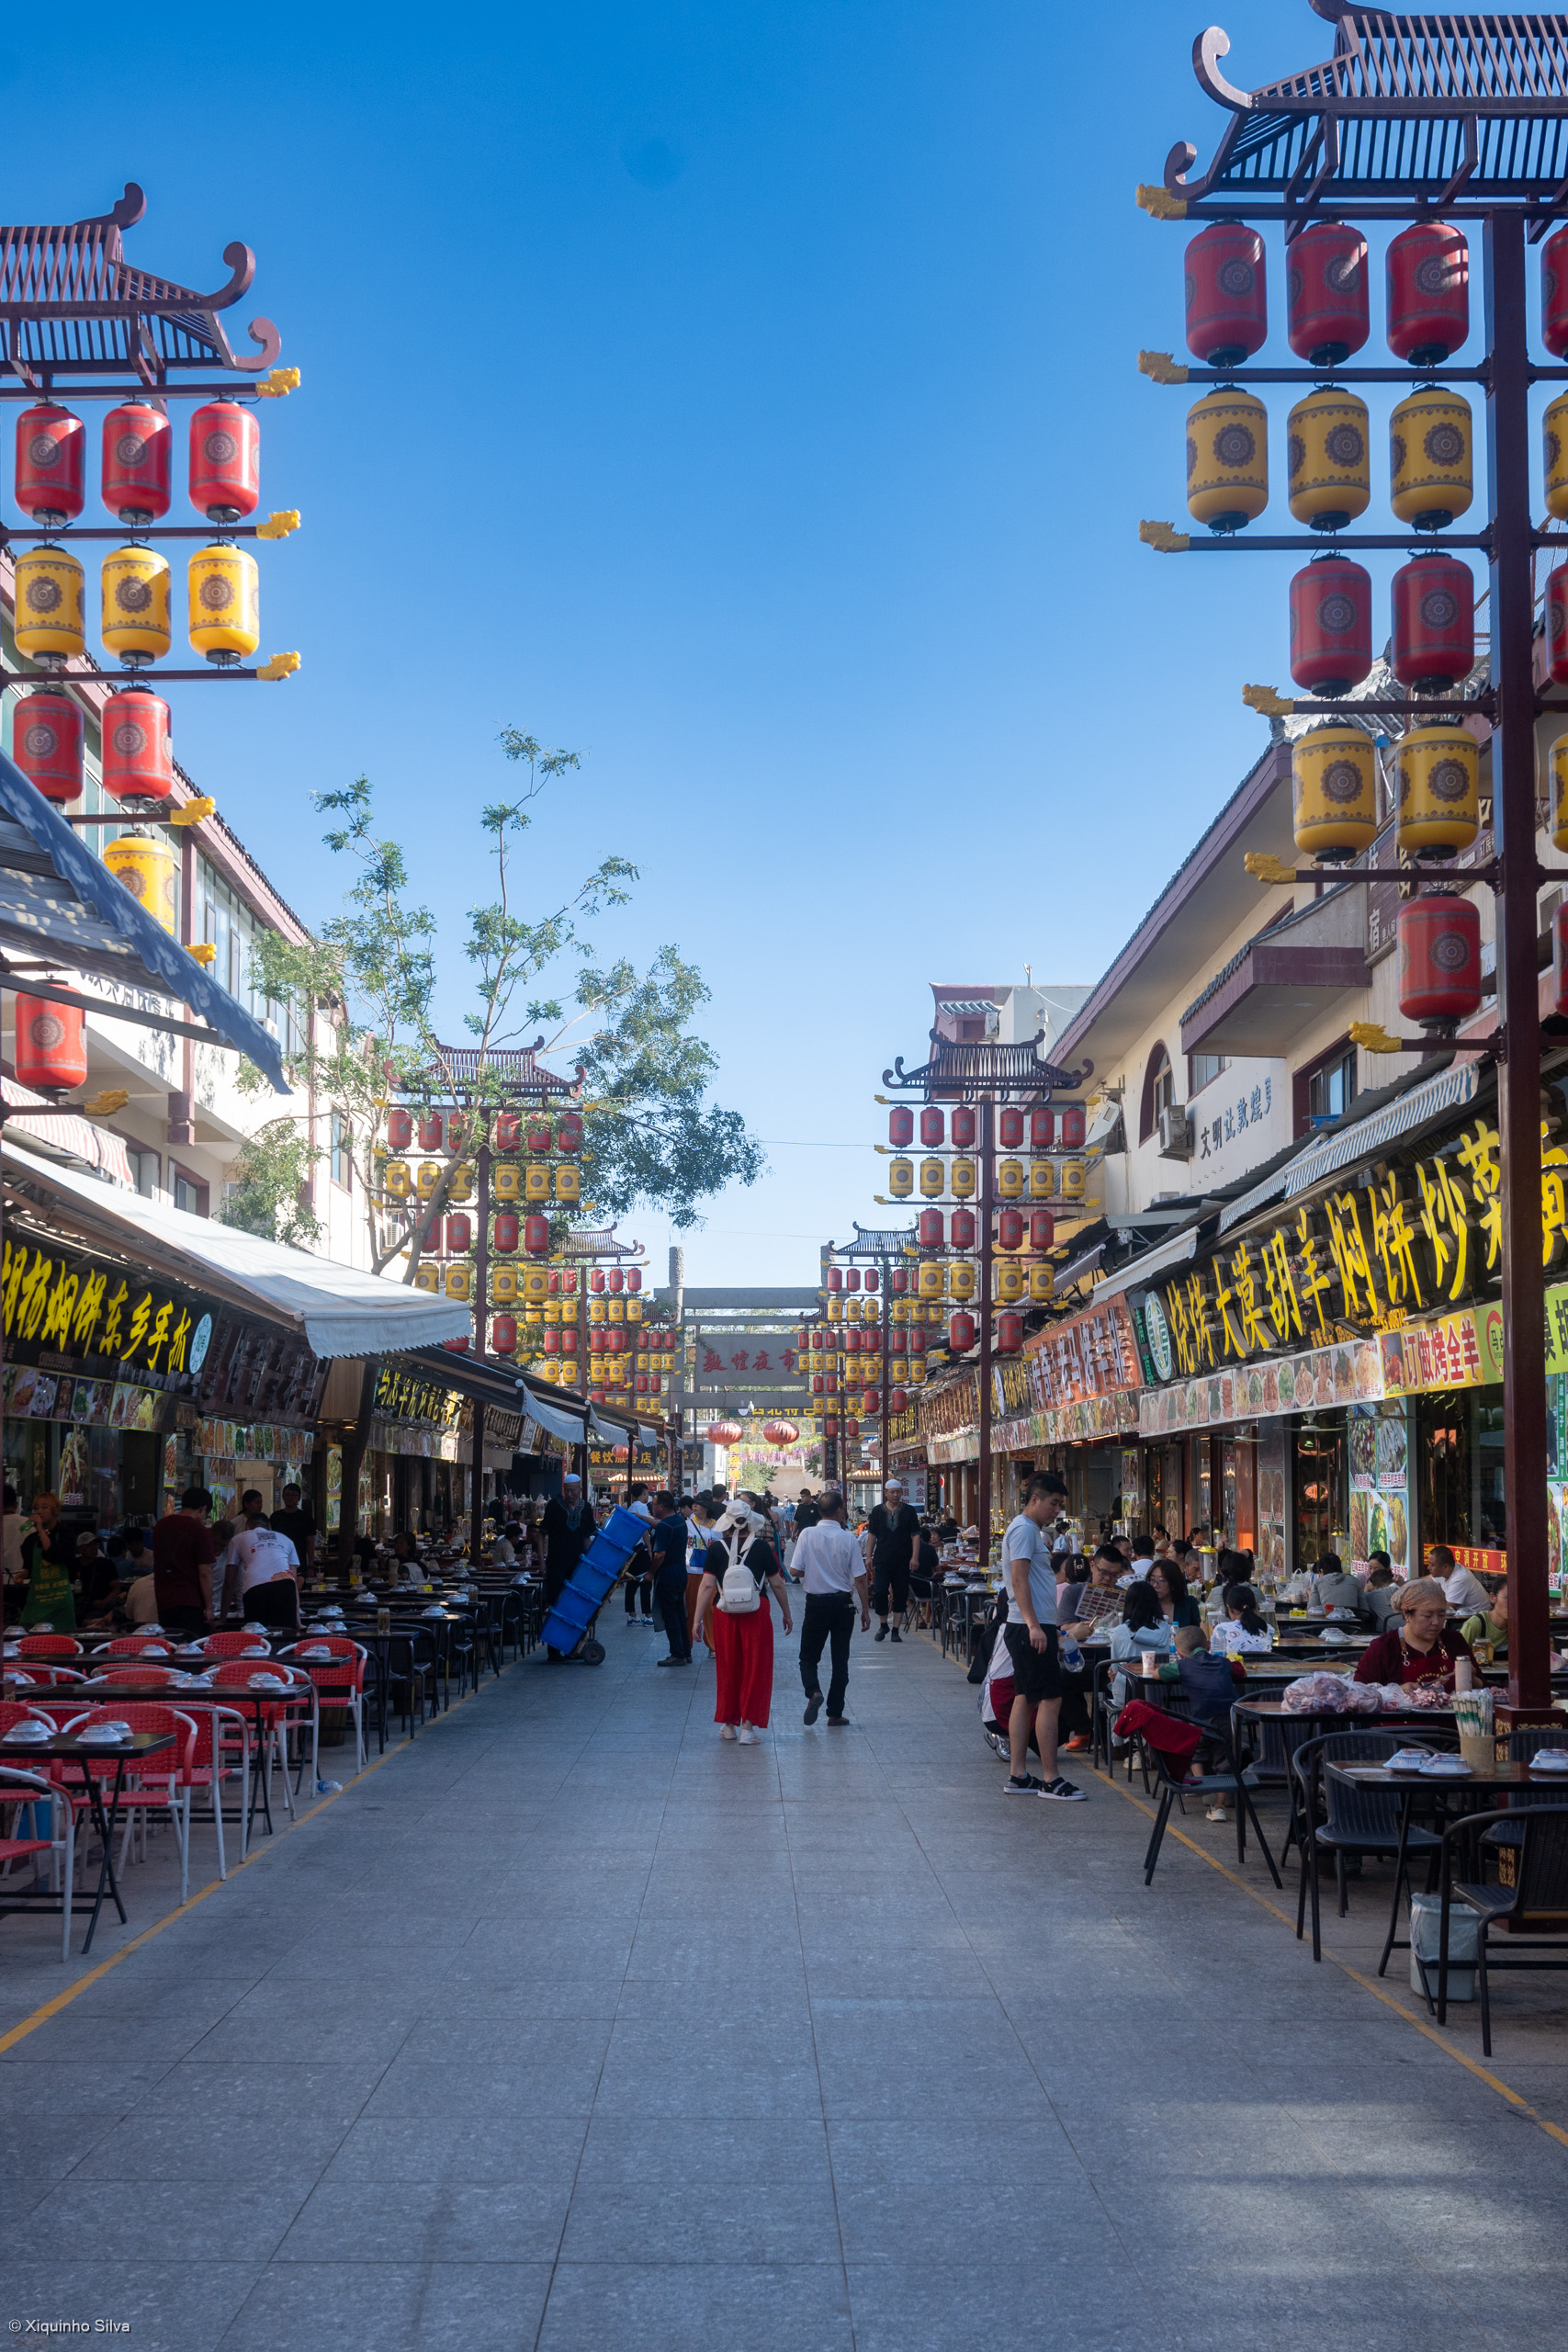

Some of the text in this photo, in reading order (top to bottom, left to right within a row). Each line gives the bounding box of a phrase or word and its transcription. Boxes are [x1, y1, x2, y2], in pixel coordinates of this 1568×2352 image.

[703, 1348, 796, 1373] 敦煌夜市
[1404, 1317, 1481, 1388] 订做烤全羊
[1454, 1548, 1489, 1570] 空调开放
